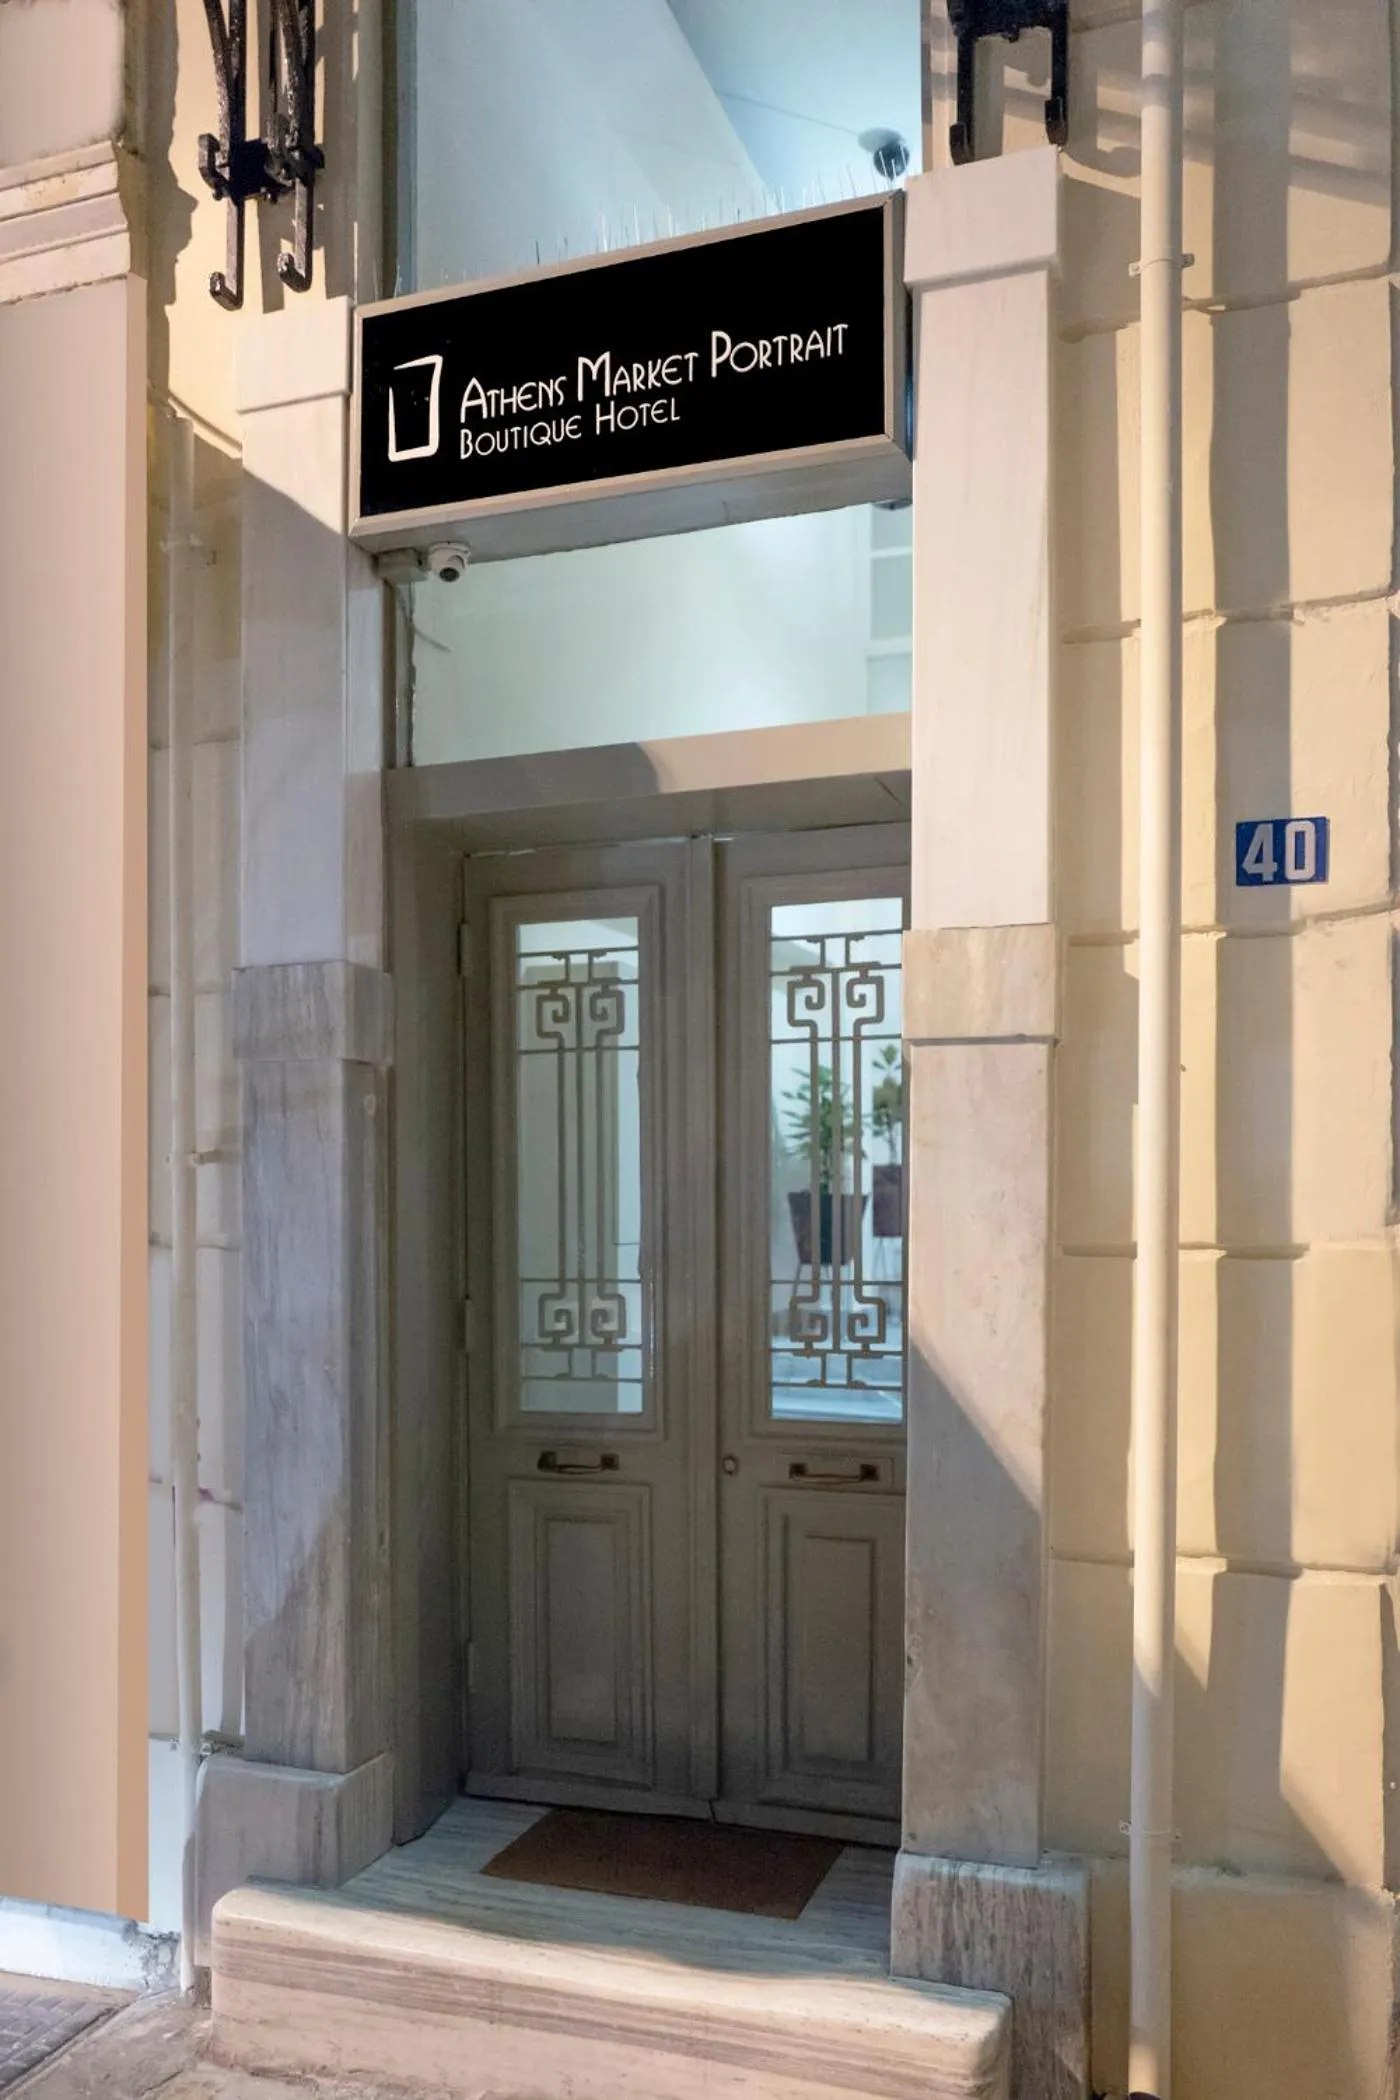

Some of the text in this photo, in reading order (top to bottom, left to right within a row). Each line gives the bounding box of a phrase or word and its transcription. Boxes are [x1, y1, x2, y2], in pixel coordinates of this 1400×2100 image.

[460, 323, 849, 424] ATHENS MARKET PORTRAIT
[460, 397, 681, 460] BOUTIQUE HOTEL
[1242, 820, 1316, 881] 40
